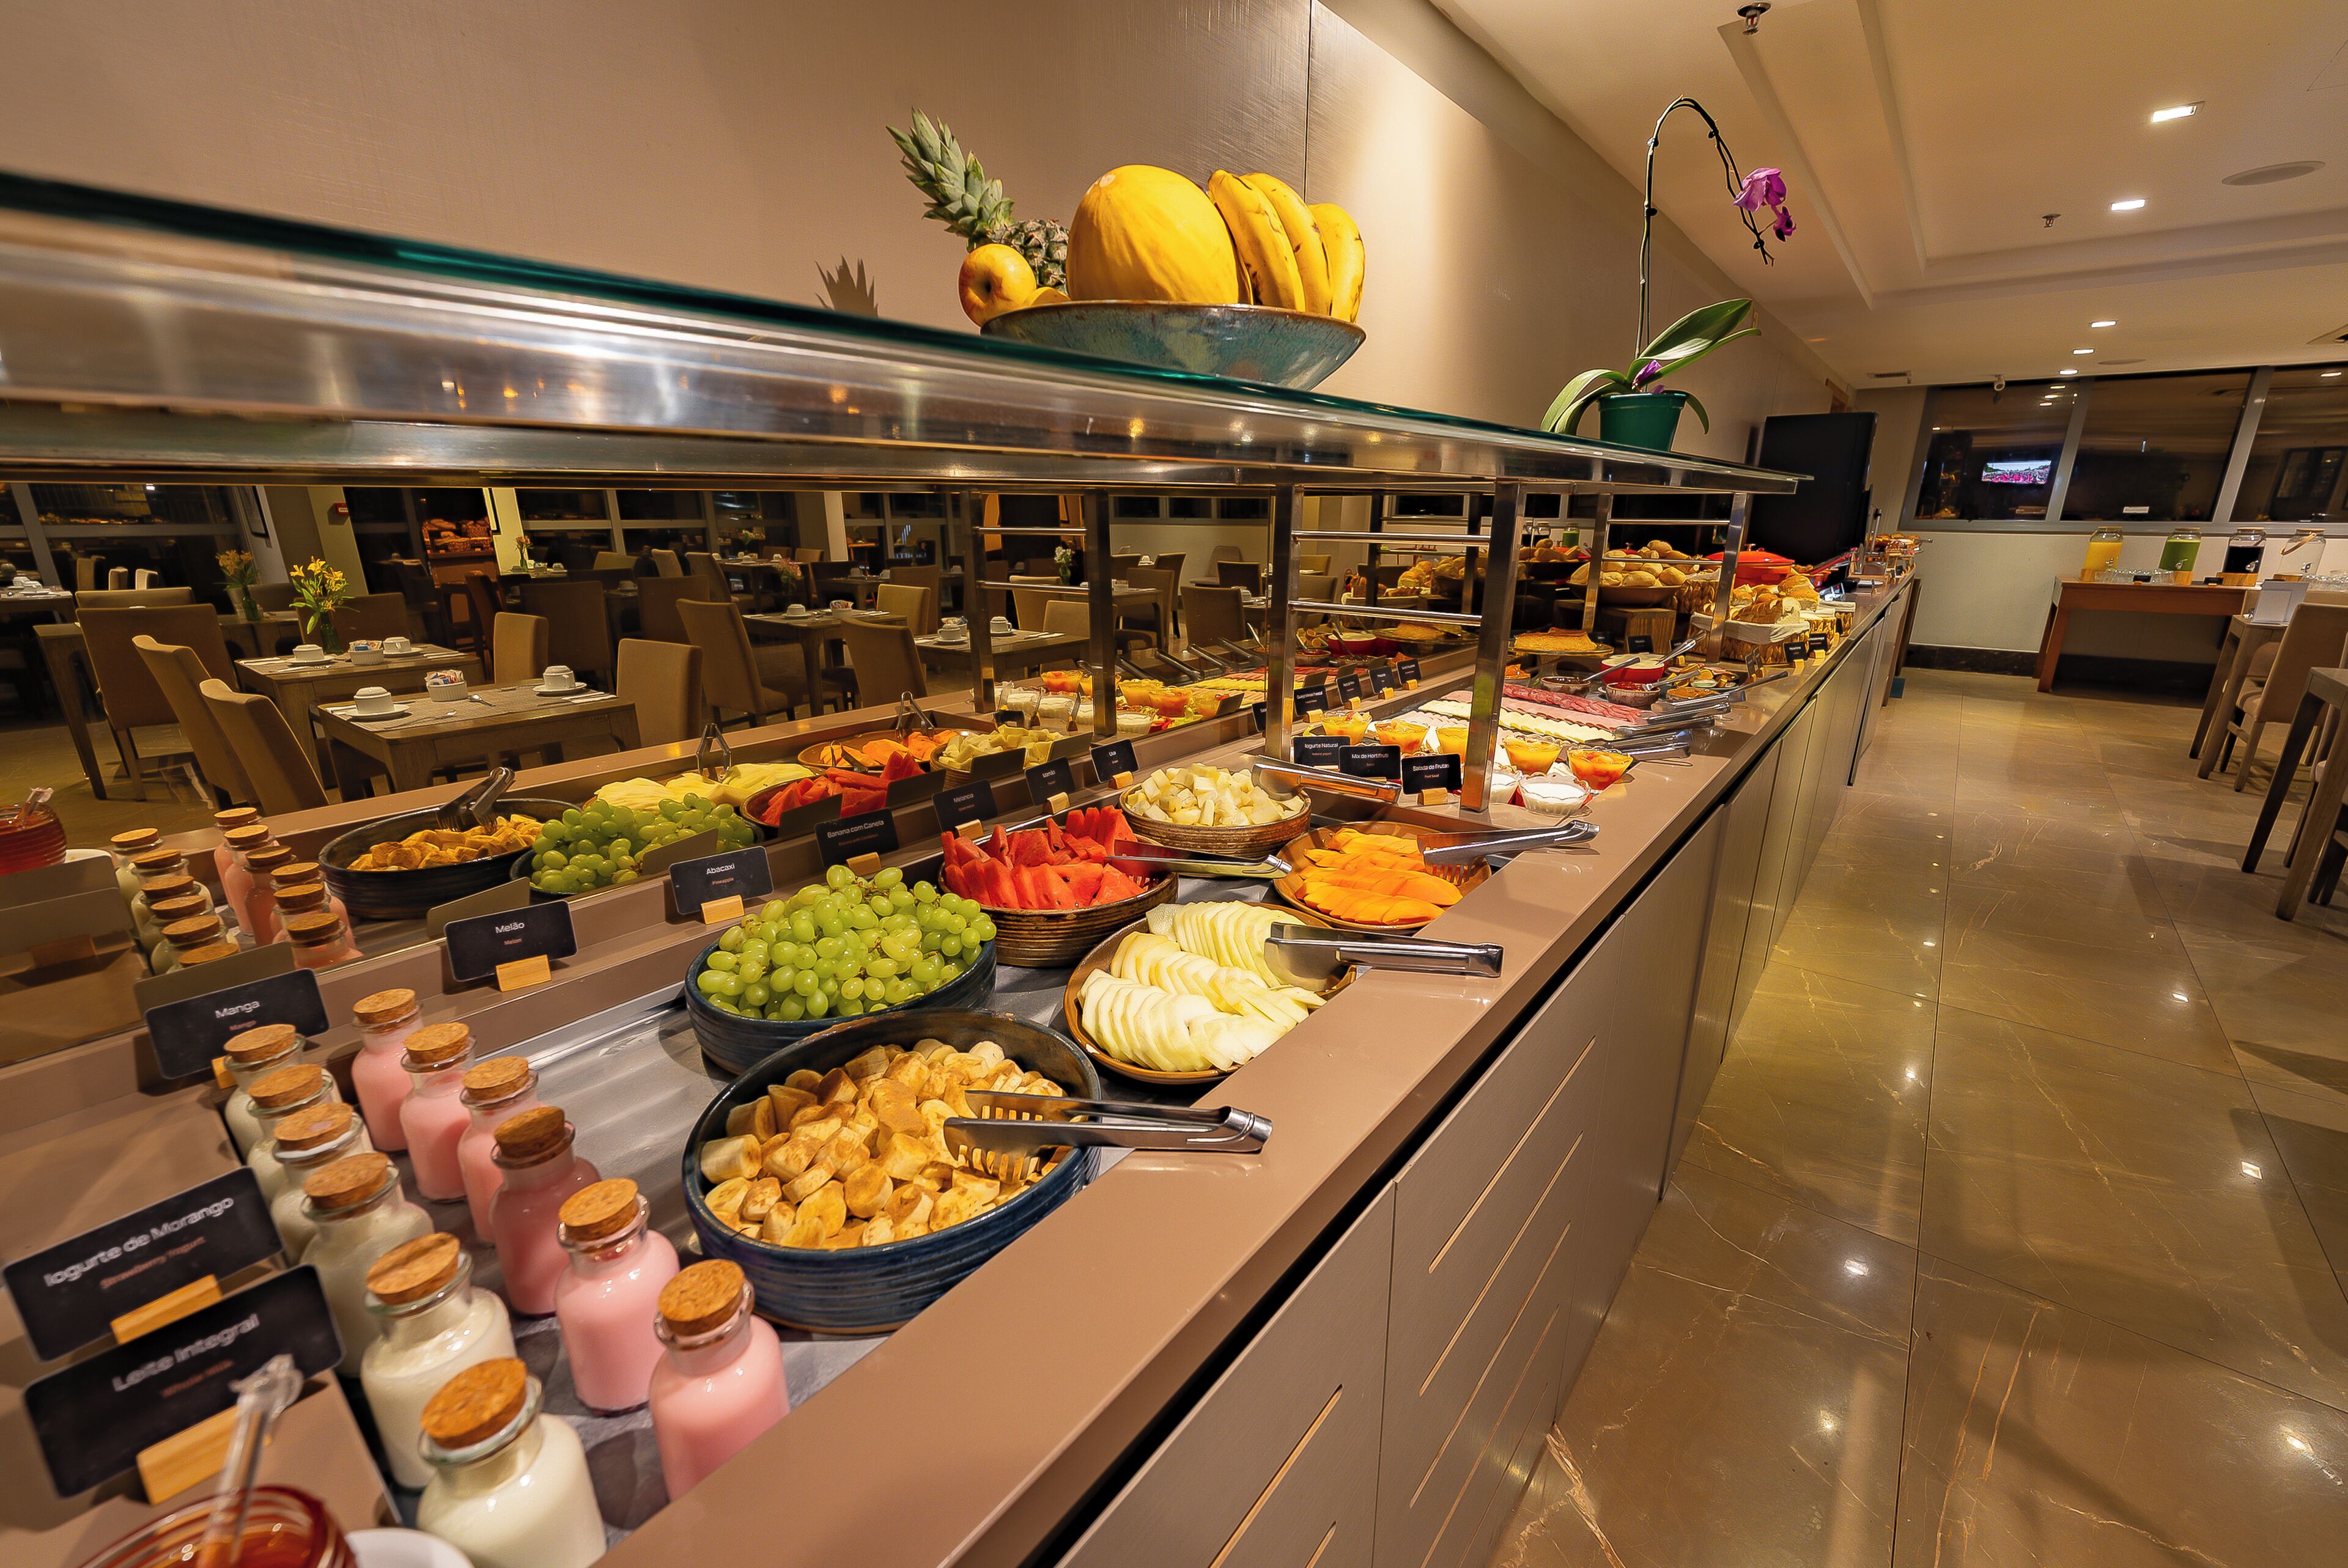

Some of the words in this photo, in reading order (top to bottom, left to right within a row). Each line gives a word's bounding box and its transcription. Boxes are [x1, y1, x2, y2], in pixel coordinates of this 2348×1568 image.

[827, 828, 851, 838] Banana
[863, 820, 884, 829] Canela
[706, 863, 734, 874] Abacaxi
[495, 922, 525, 933] Melão
[215, 1001, 260, 1018] Manga
[43, 1246, 122, 1287] Iogurte
[123, 1234, 151, 1253] de
[150, 1198, 234, 1240] Morango
[112, 1355, 175, 1392] Leite
[174, 1313, 260, 1363] Integral
